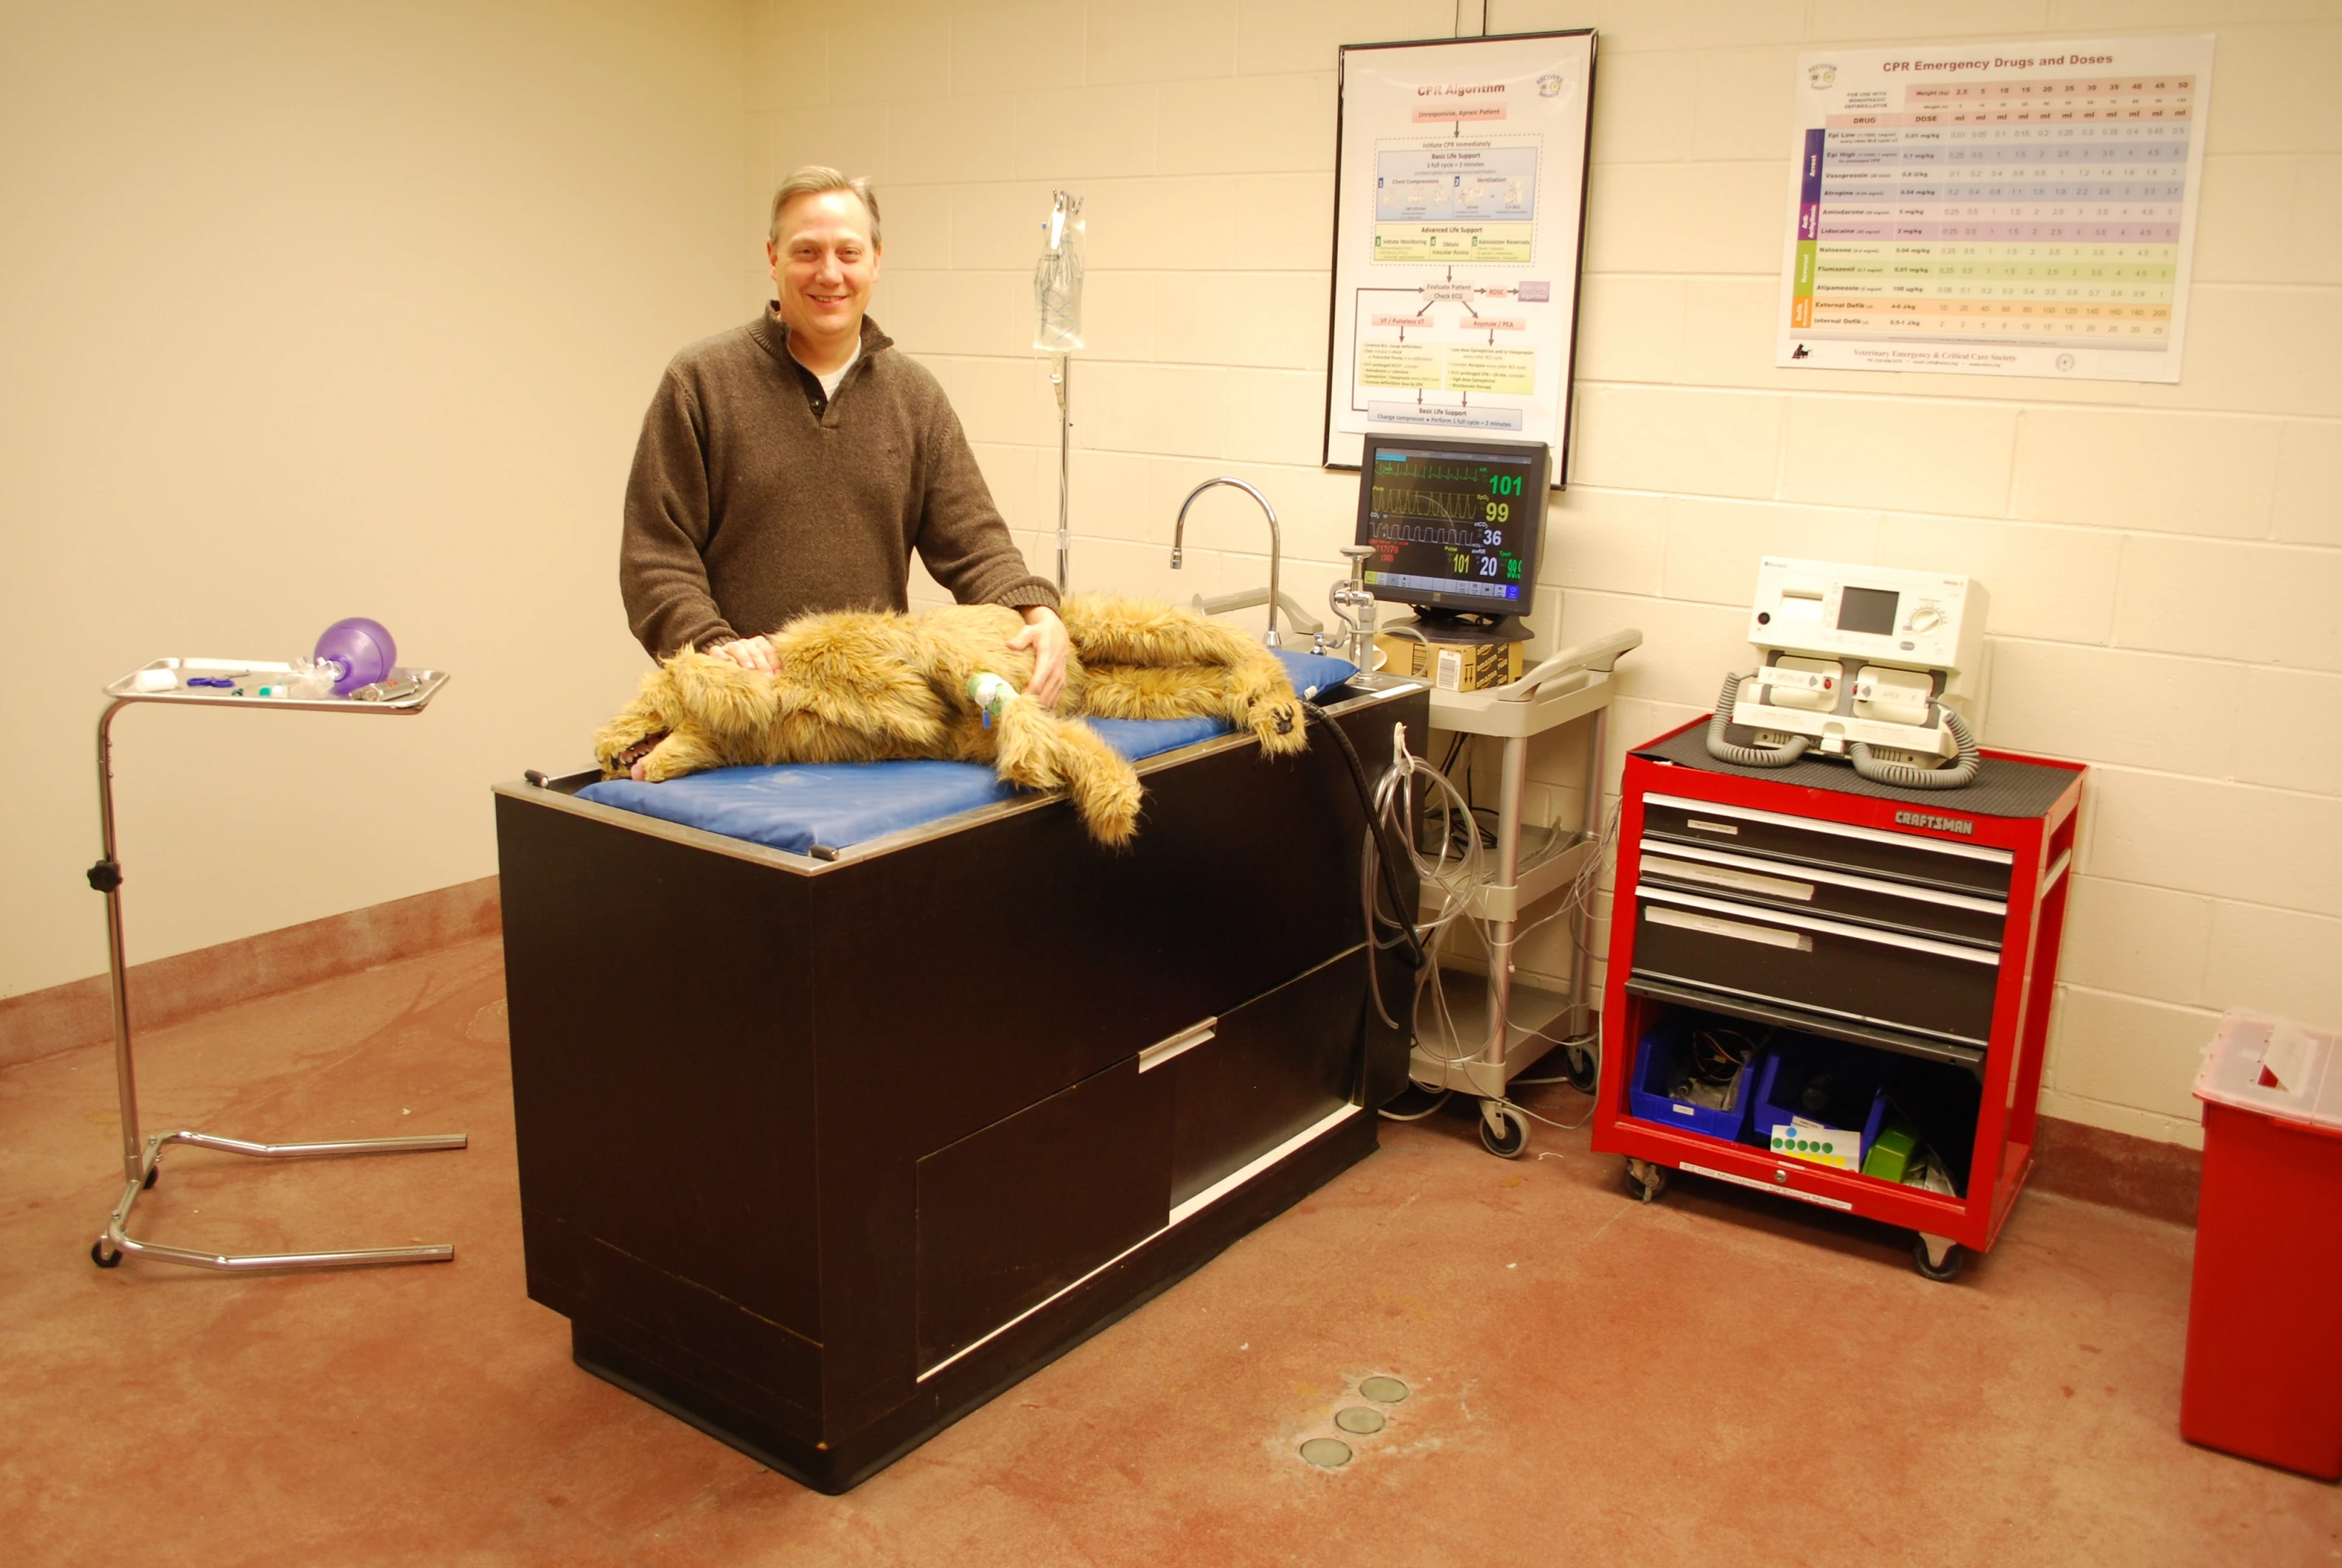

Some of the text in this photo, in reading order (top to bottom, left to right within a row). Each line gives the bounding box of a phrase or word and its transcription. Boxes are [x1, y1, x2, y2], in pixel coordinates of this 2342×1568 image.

[1883, 54, 2113, 72] CPR Emergency Drugs and Doses
[1446, 83, 1505, 97] Algorithm
[1458, 152, 1480, 160] Support
[1892, 351, 1931, 359] Emergency
[1490, 475, 1521, 495] 101
[1486, 502, 1509, 522] 99
[1482, 529, 1502, 546] 36
[1453, 554, 1469, 573] 101
[1480, 557, 1497, 576] 20
[1895, 811, 1972, 834] CRAFTSMAN
